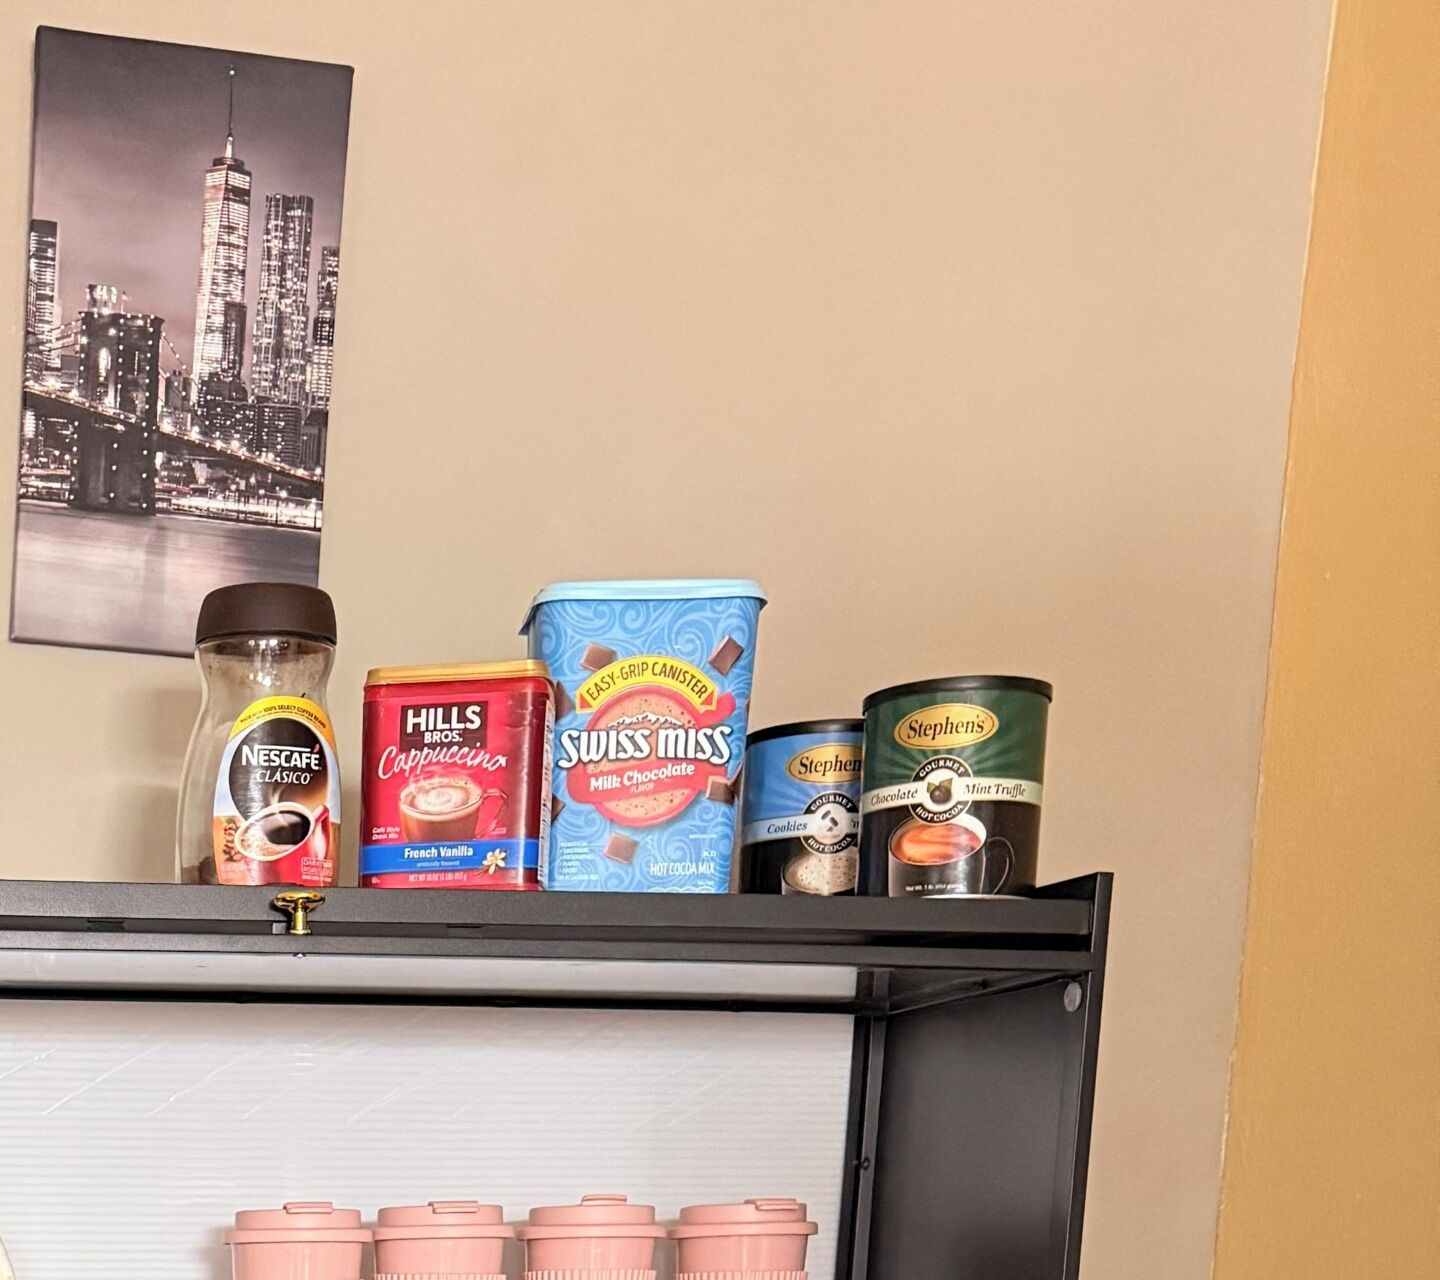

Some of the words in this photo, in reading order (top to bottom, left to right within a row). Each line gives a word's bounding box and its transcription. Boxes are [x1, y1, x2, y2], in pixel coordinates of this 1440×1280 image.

[587, 662, 649, 701] EASY-GRIP
[652, 662, 708, 699] CANISTER
[407, 706, 481, 733] HILLS
[907, 714, 985, 740] Stephen's
[424, 731, 463, 743] BROS.
[242, 744, 319, 770] NESCAFÉ
[378, 742, 507, 779] Cappuccino
[799, 755, 861, 776] Stephen
[257, 768, 310, 784] CLÁSICO
[590, 774, 621, 792] Milk
[623, 762, 695, 786] Chocolate
[919, 759, 965, 777] GOURMET
[810, 795, 853, 811] GOURMET
[871, 789, 918, 806] Chocolate
[964, 784, 991, 795] Mint
[994, 784, 1026, 798] Truffle
[916, 806, 933, 821] HOT
[934, 804, 964, 822] COCOA
[768, 821, 807, 834] Cookies
[405, 847, 437, 859] French
[440, 846, 473, 857] Vanilla
[808, 838, 824, 852] HOT
[825, 837, 852, 853] COCOA
[651, 863, 667, 875] HOT
[669, 863, 696, 875] COCOA
[699, 862, 715, 874] MIX
